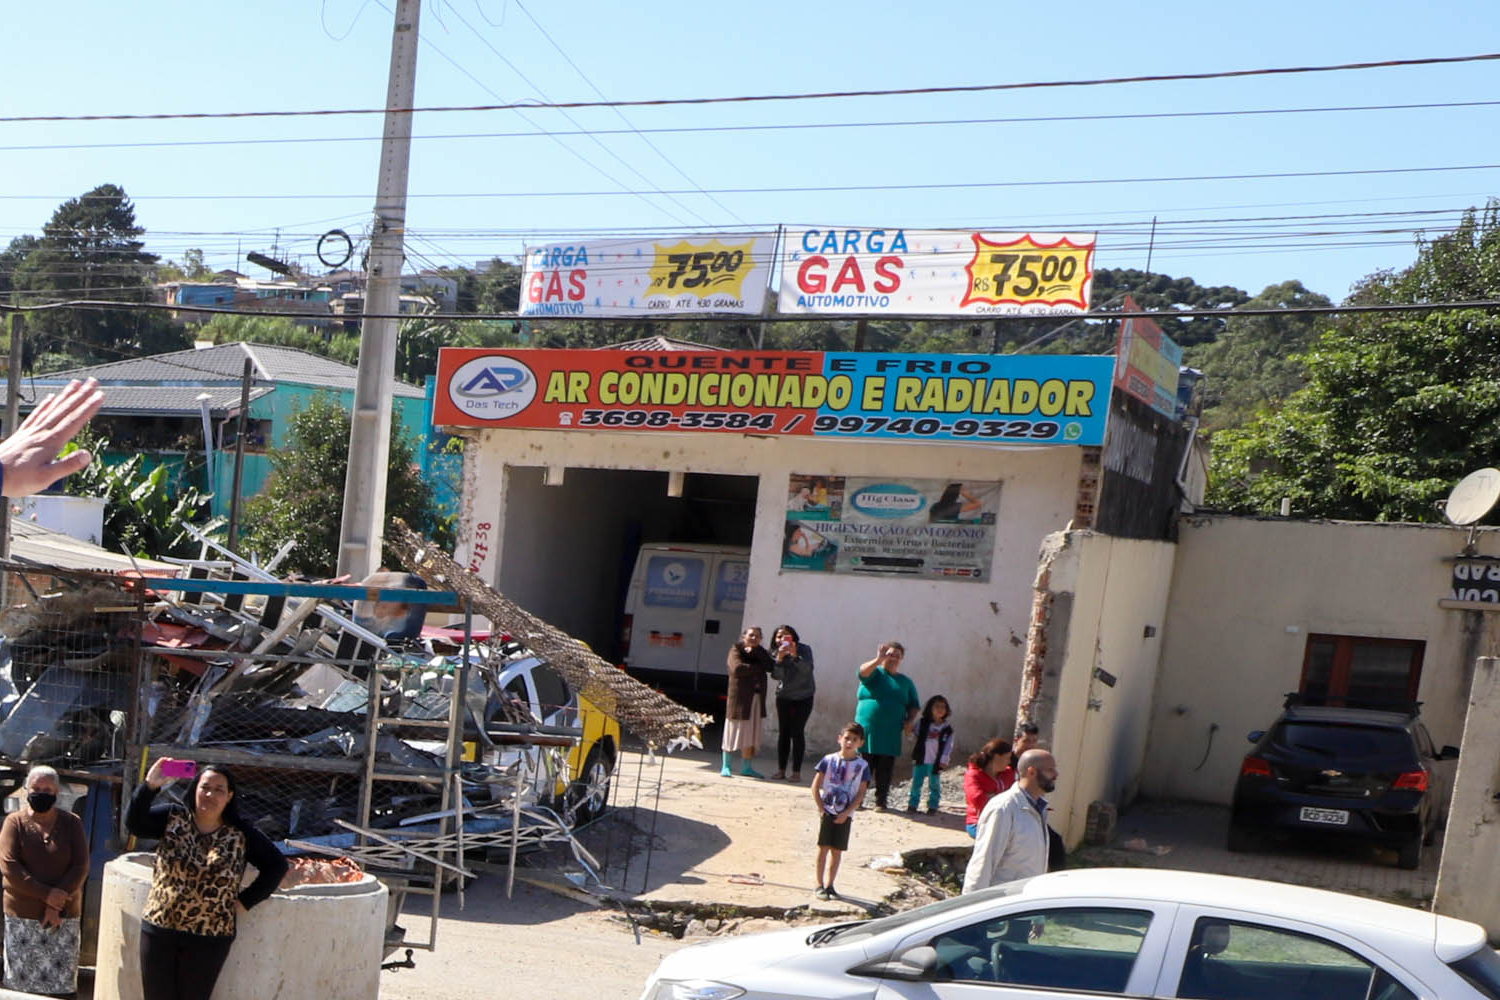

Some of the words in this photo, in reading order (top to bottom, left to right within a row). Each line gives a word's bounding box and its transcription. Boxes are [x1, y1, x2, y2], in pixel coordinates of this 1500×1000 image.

[802, 229, 908, 254] CARGA
[531, 246, 589, 268] CARGA
[713, 299, 745, 309] GRAMAS
[796, 295, 890, 308] AUTOMOTIVO
[625, 356, 812, 371] QUENTE
[830, 358, 857, 371] E
[876, 359, 992, 375] FRIO
[543, 370, 591, 404] AR
[598, 370, 853, 410] CONDICIONADO
[861, 375, 886, 411] E
[894, 376, 1096, 417] RADIADOR
[493, 400, 519, 409] Tech
[579, 409, 776, 430] 3698-3584
[813, 414, 1059, 439] 99740-9329
